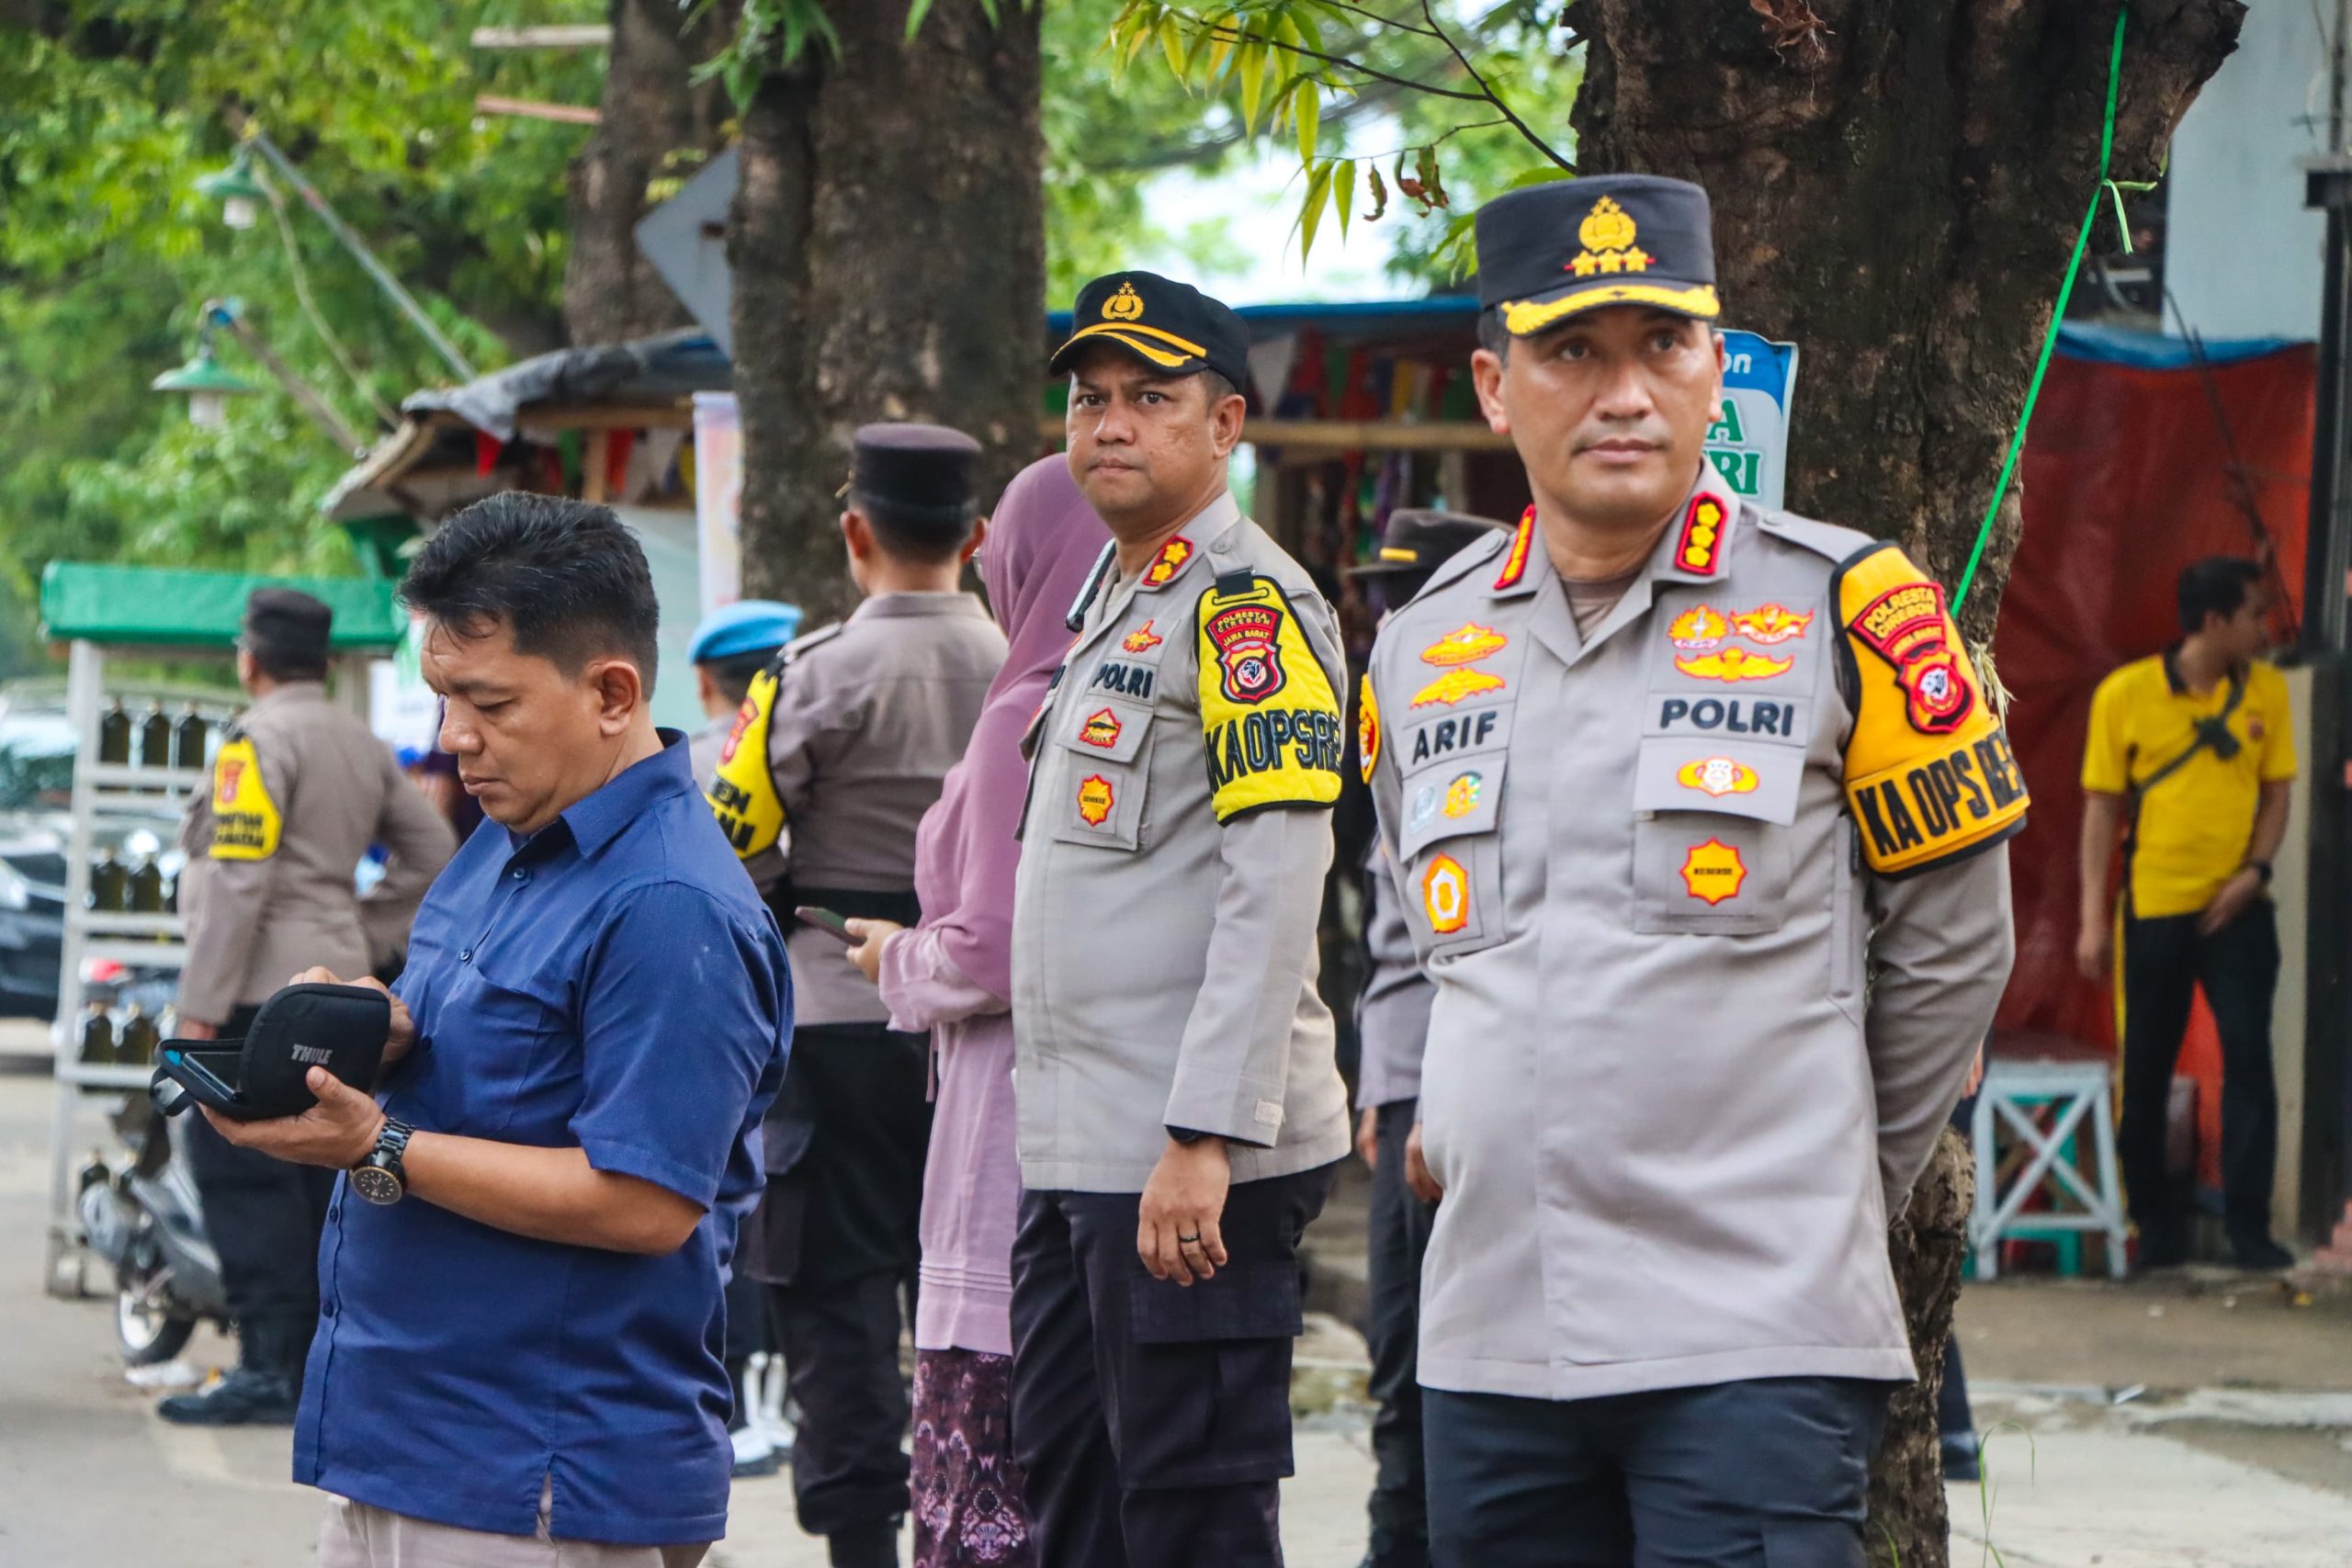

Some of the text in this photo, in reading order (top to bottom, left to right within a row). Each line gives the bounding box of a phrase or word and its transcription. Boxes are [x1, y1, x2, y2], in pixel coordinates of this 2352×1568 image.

[1704, 450, 1760, 495] RI
[1216, 611, 1268, 627] POLRESTA
[1862, 587, 1938, 633] POLRESTA
[1875, 605, 1938, 638] CIREBON
[1223, 629, 1270, 647] JAWA BARAT
[1091, 662, 1154, 700] POLRI
[1659, 698, 1794, 738] POLRI
[1412, 711, 1498, 765] ARIF
[290, 1043, 333, 1065] THULE
